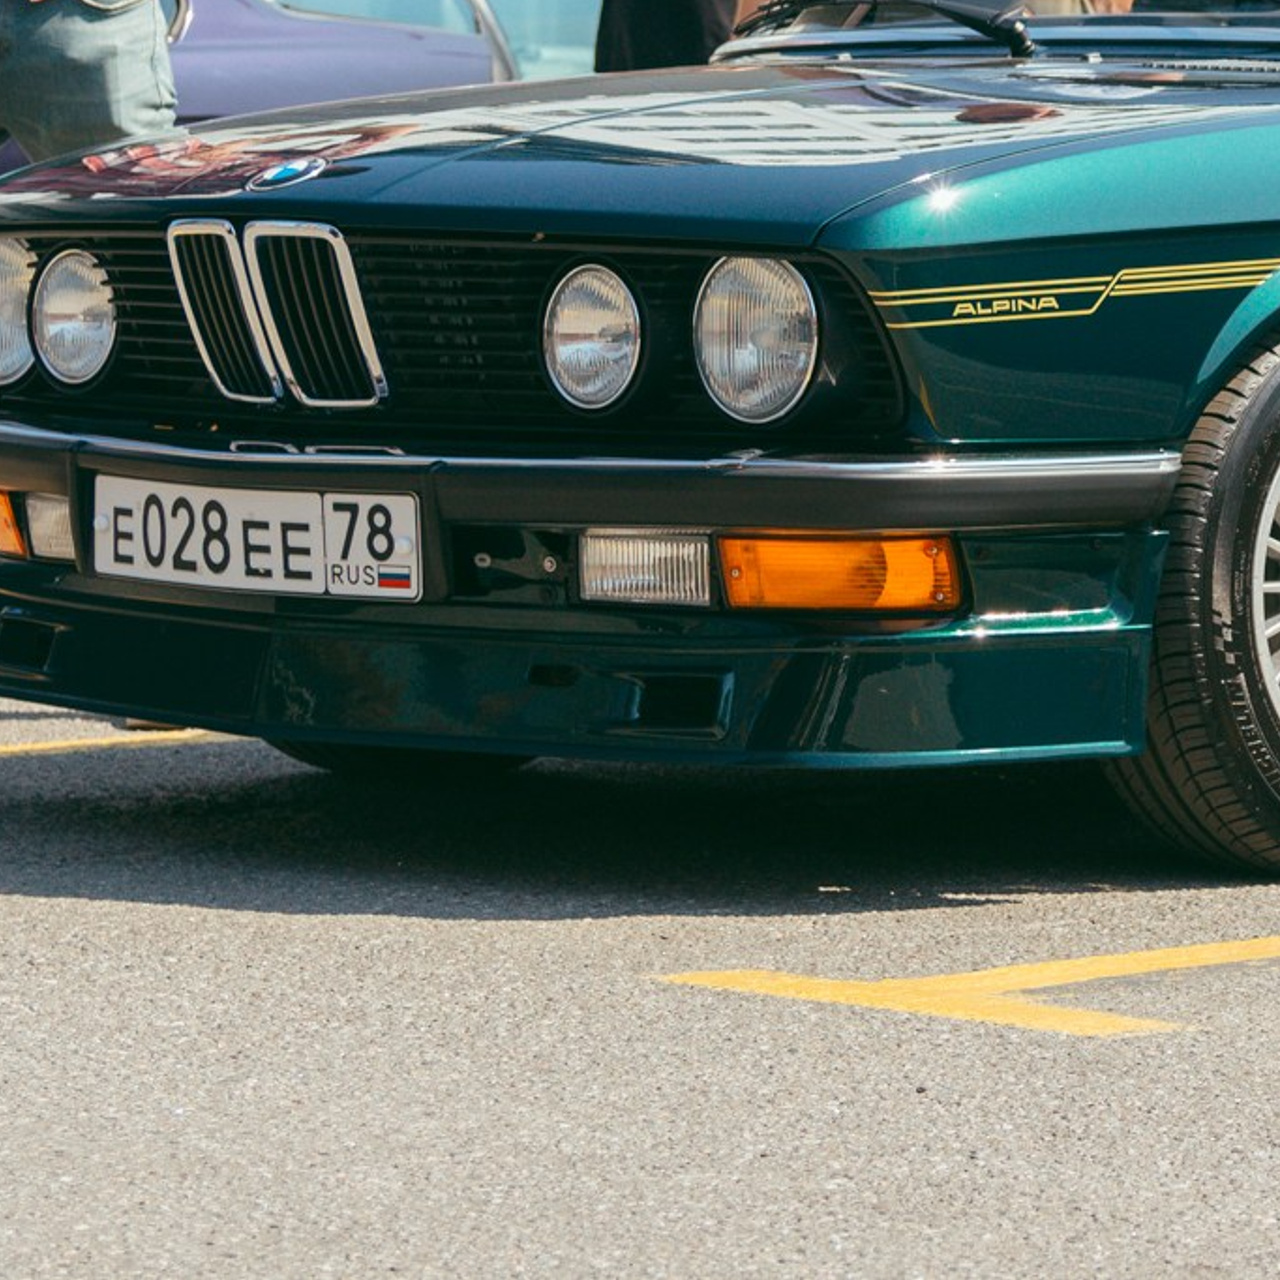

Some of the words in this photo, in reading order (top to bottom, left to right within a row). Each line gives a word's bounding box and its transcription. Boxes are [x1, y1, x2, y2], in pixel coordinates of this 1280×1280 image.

[952, 296, 1060, 317] ALPINA
[331, 502, 395, 562] 78
[331, 563, 375, 586] RUS
